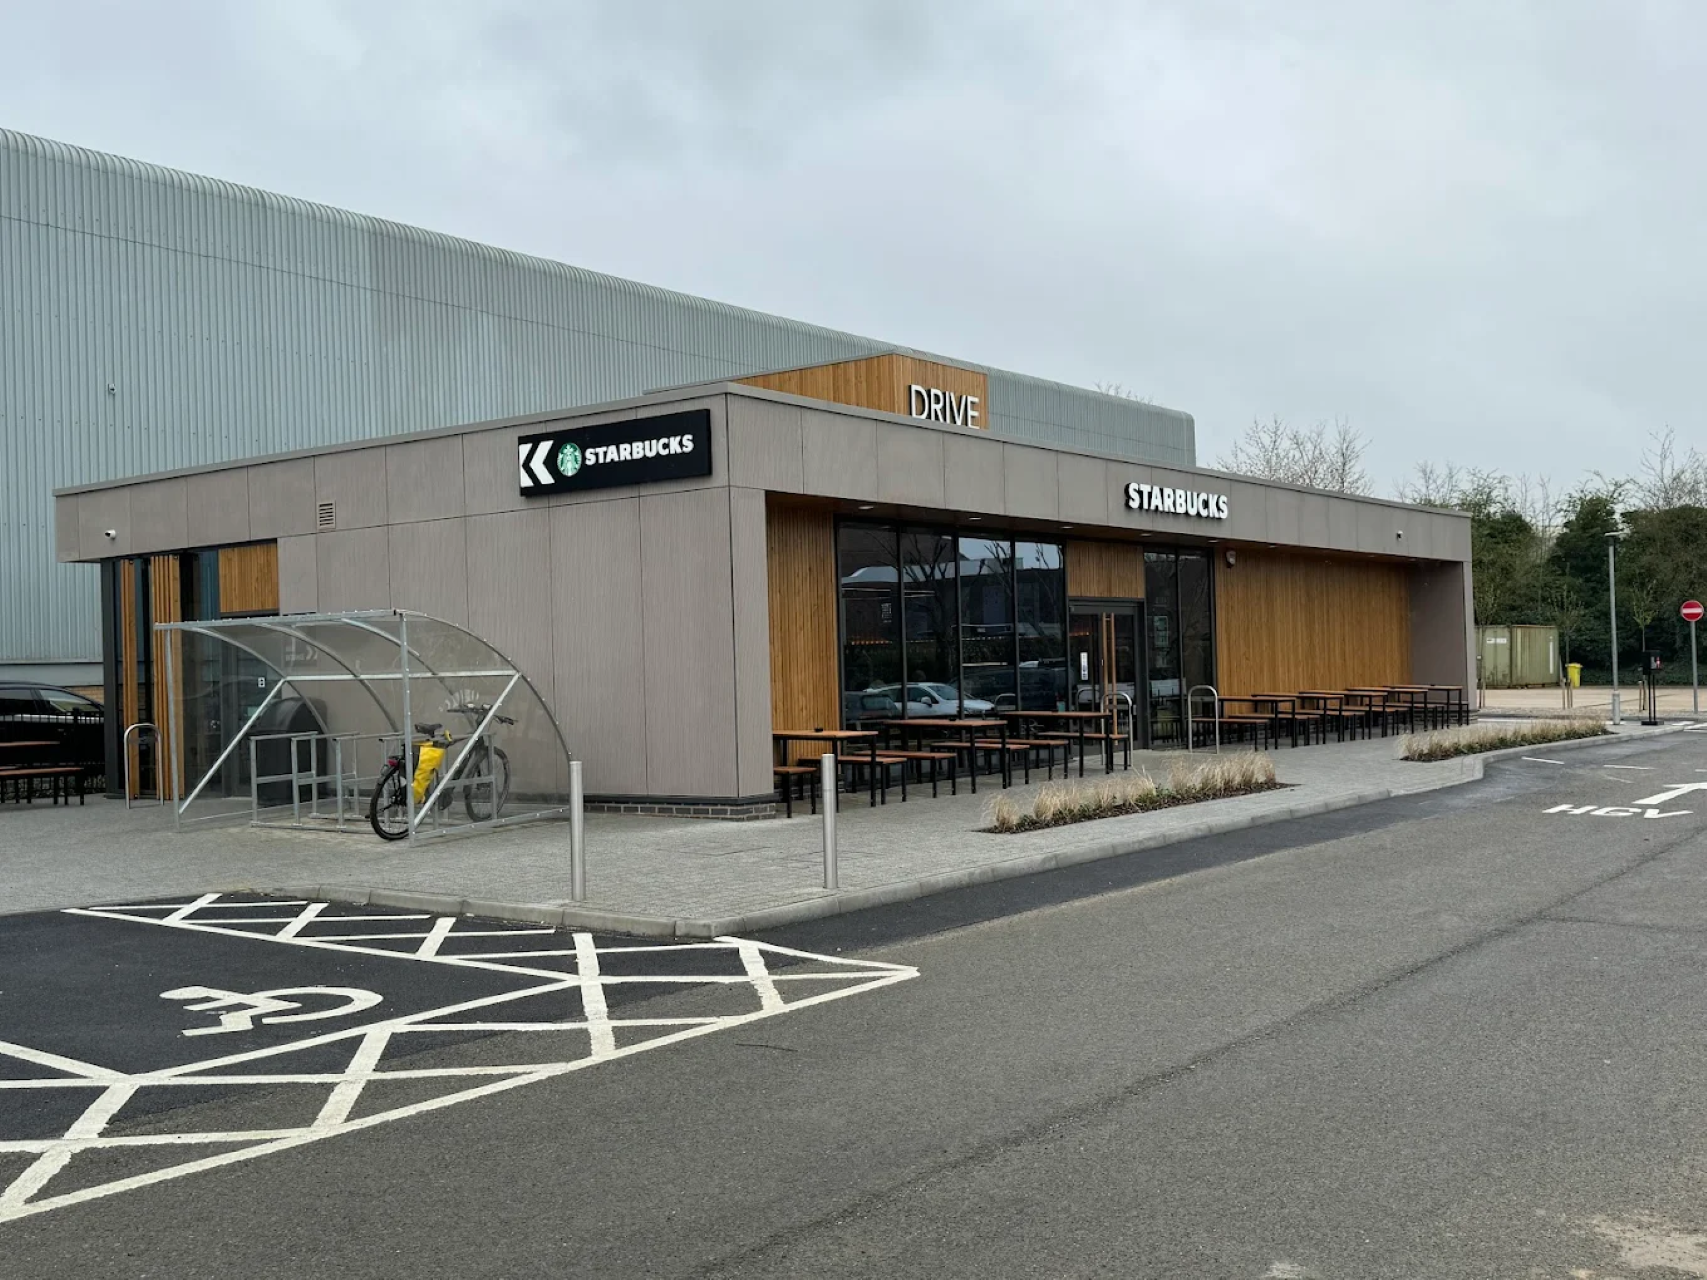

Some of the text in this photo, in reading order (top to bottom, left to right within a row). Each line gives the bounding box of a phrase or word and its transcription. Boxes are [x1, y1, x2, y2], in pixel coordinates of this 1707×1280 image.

[910, 384, 980, 430] DRIVE
[584, 434, 695, 466] STARBUCKS
[1127, 482, 1229, 519] STARBUCKS
[1542, 803, 1694, 819] HGV
